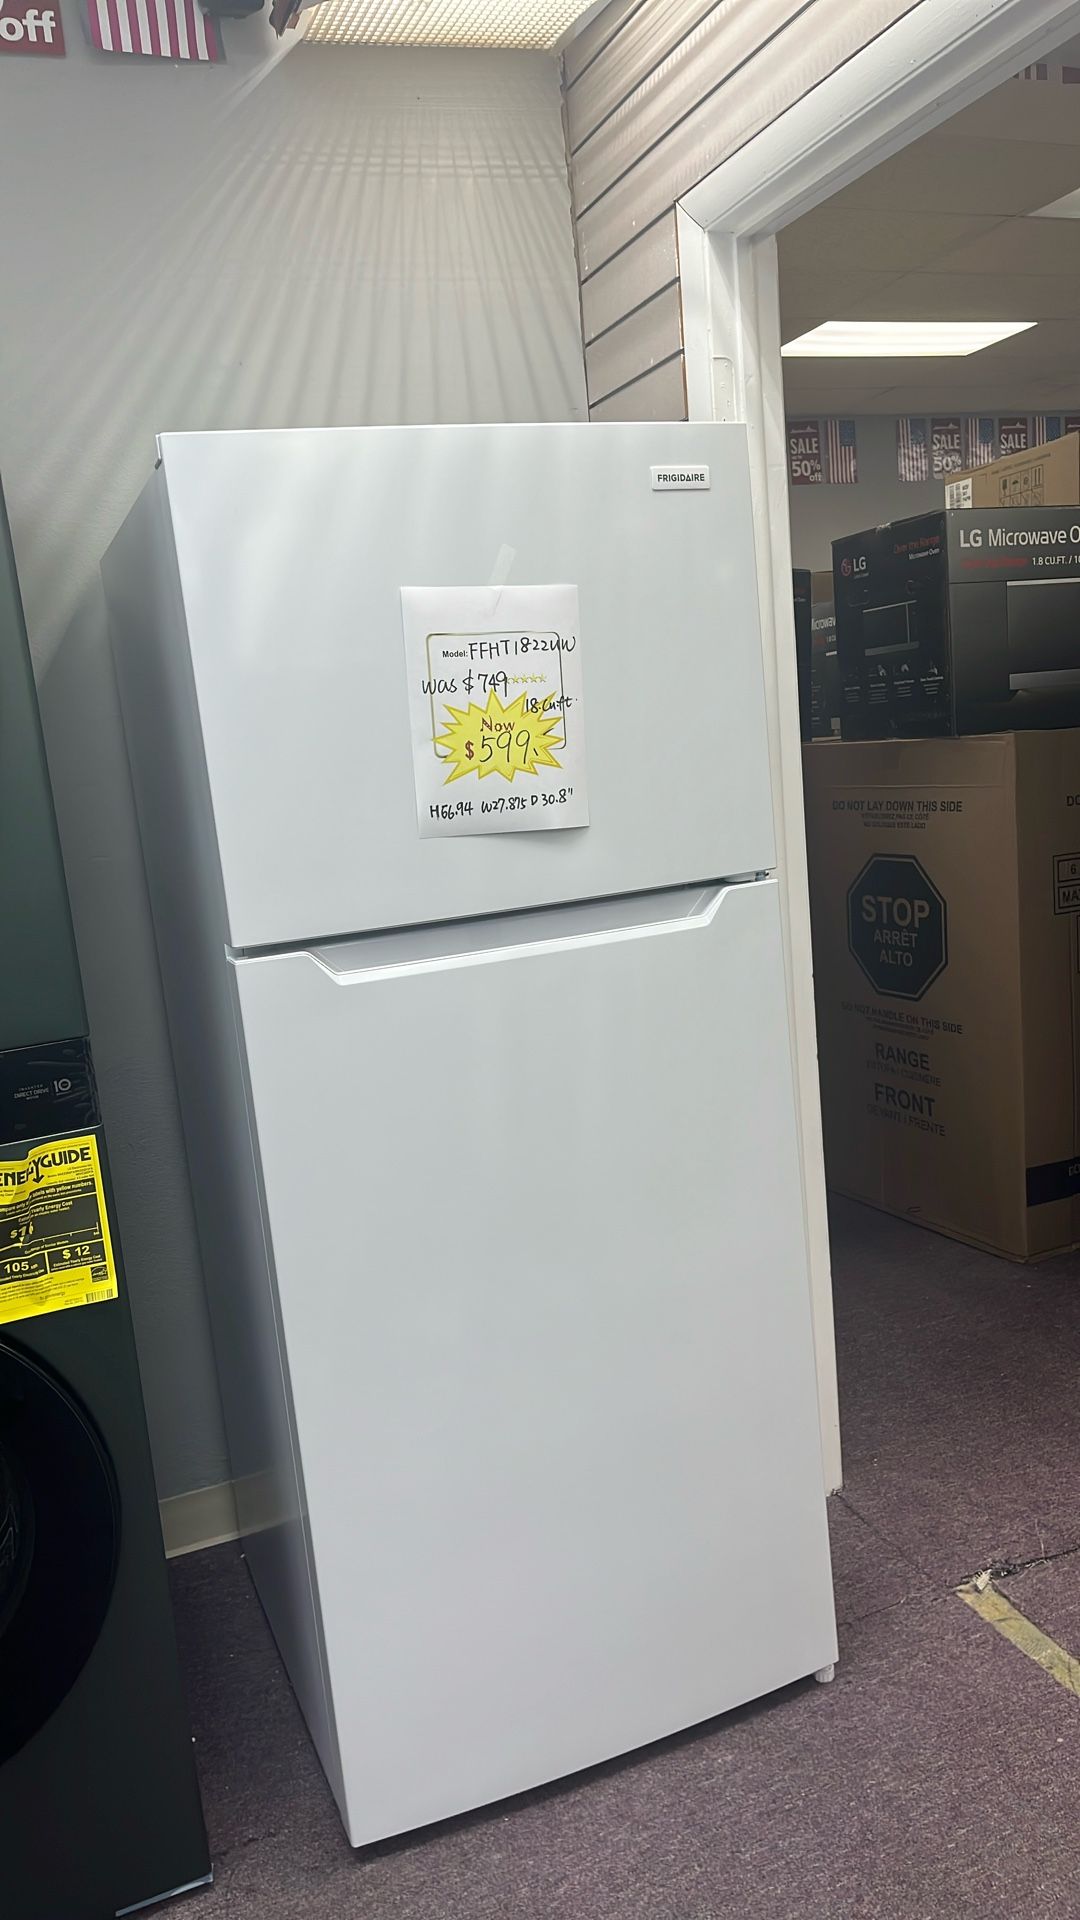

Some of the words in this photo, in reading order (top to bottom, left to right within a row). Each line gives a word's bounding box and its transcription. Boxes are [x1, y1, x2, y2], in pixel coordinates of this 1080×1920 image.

[0, 9, 56, 43] off
[790, 438, 818, 454] SALE
[933, 434, 960, 450] SALE
[1000, 433, 1026, 448] SALE
[792, 459, 821, 477] 50%
[933, 455, 961, 473] 50%
[657, 473, 705, 482] FRIGIDAIRE
[960, 529, 982, 548] LG
[988, 528, 1067, 547] Microwave
[853, 556, 867, 572] LG
[1032, 557, 1044, 566] 1.8
[442, 650, 469, 658] Model:
[480, 715, 515, 732] Now
[847, 801, 864, 811] NOT
[867, 801, 883, 811] LAY
[886, 801, 914, 812] DOWN
[917, 801, 937, 812] THIS
[940, 801, 963, 813] SIDE
[862, 895, 930, 928] STOP
[874, 928, 918, 948] ARRÊT
[880, 950, 913, 967] ALTO
[906, 1015, 919, 1025] ON
[920, 1017, 940, 1030] THIS
[942, 1021, 963, 1035] SIDE
[875, 1043, 930, 1071] RANGE
[54, 1078, 71, 1093] 10
[874, 1083, 935, 1116] FRONT
[909, 1115, 946, 1136] FRENTE
[0, 1147, 91, 1187] NEYGUIDE
[62, 1249, 71, 1260] $
[75, 1245, 91, 1256] 12
[4, 1261, 30, 1274] 105
